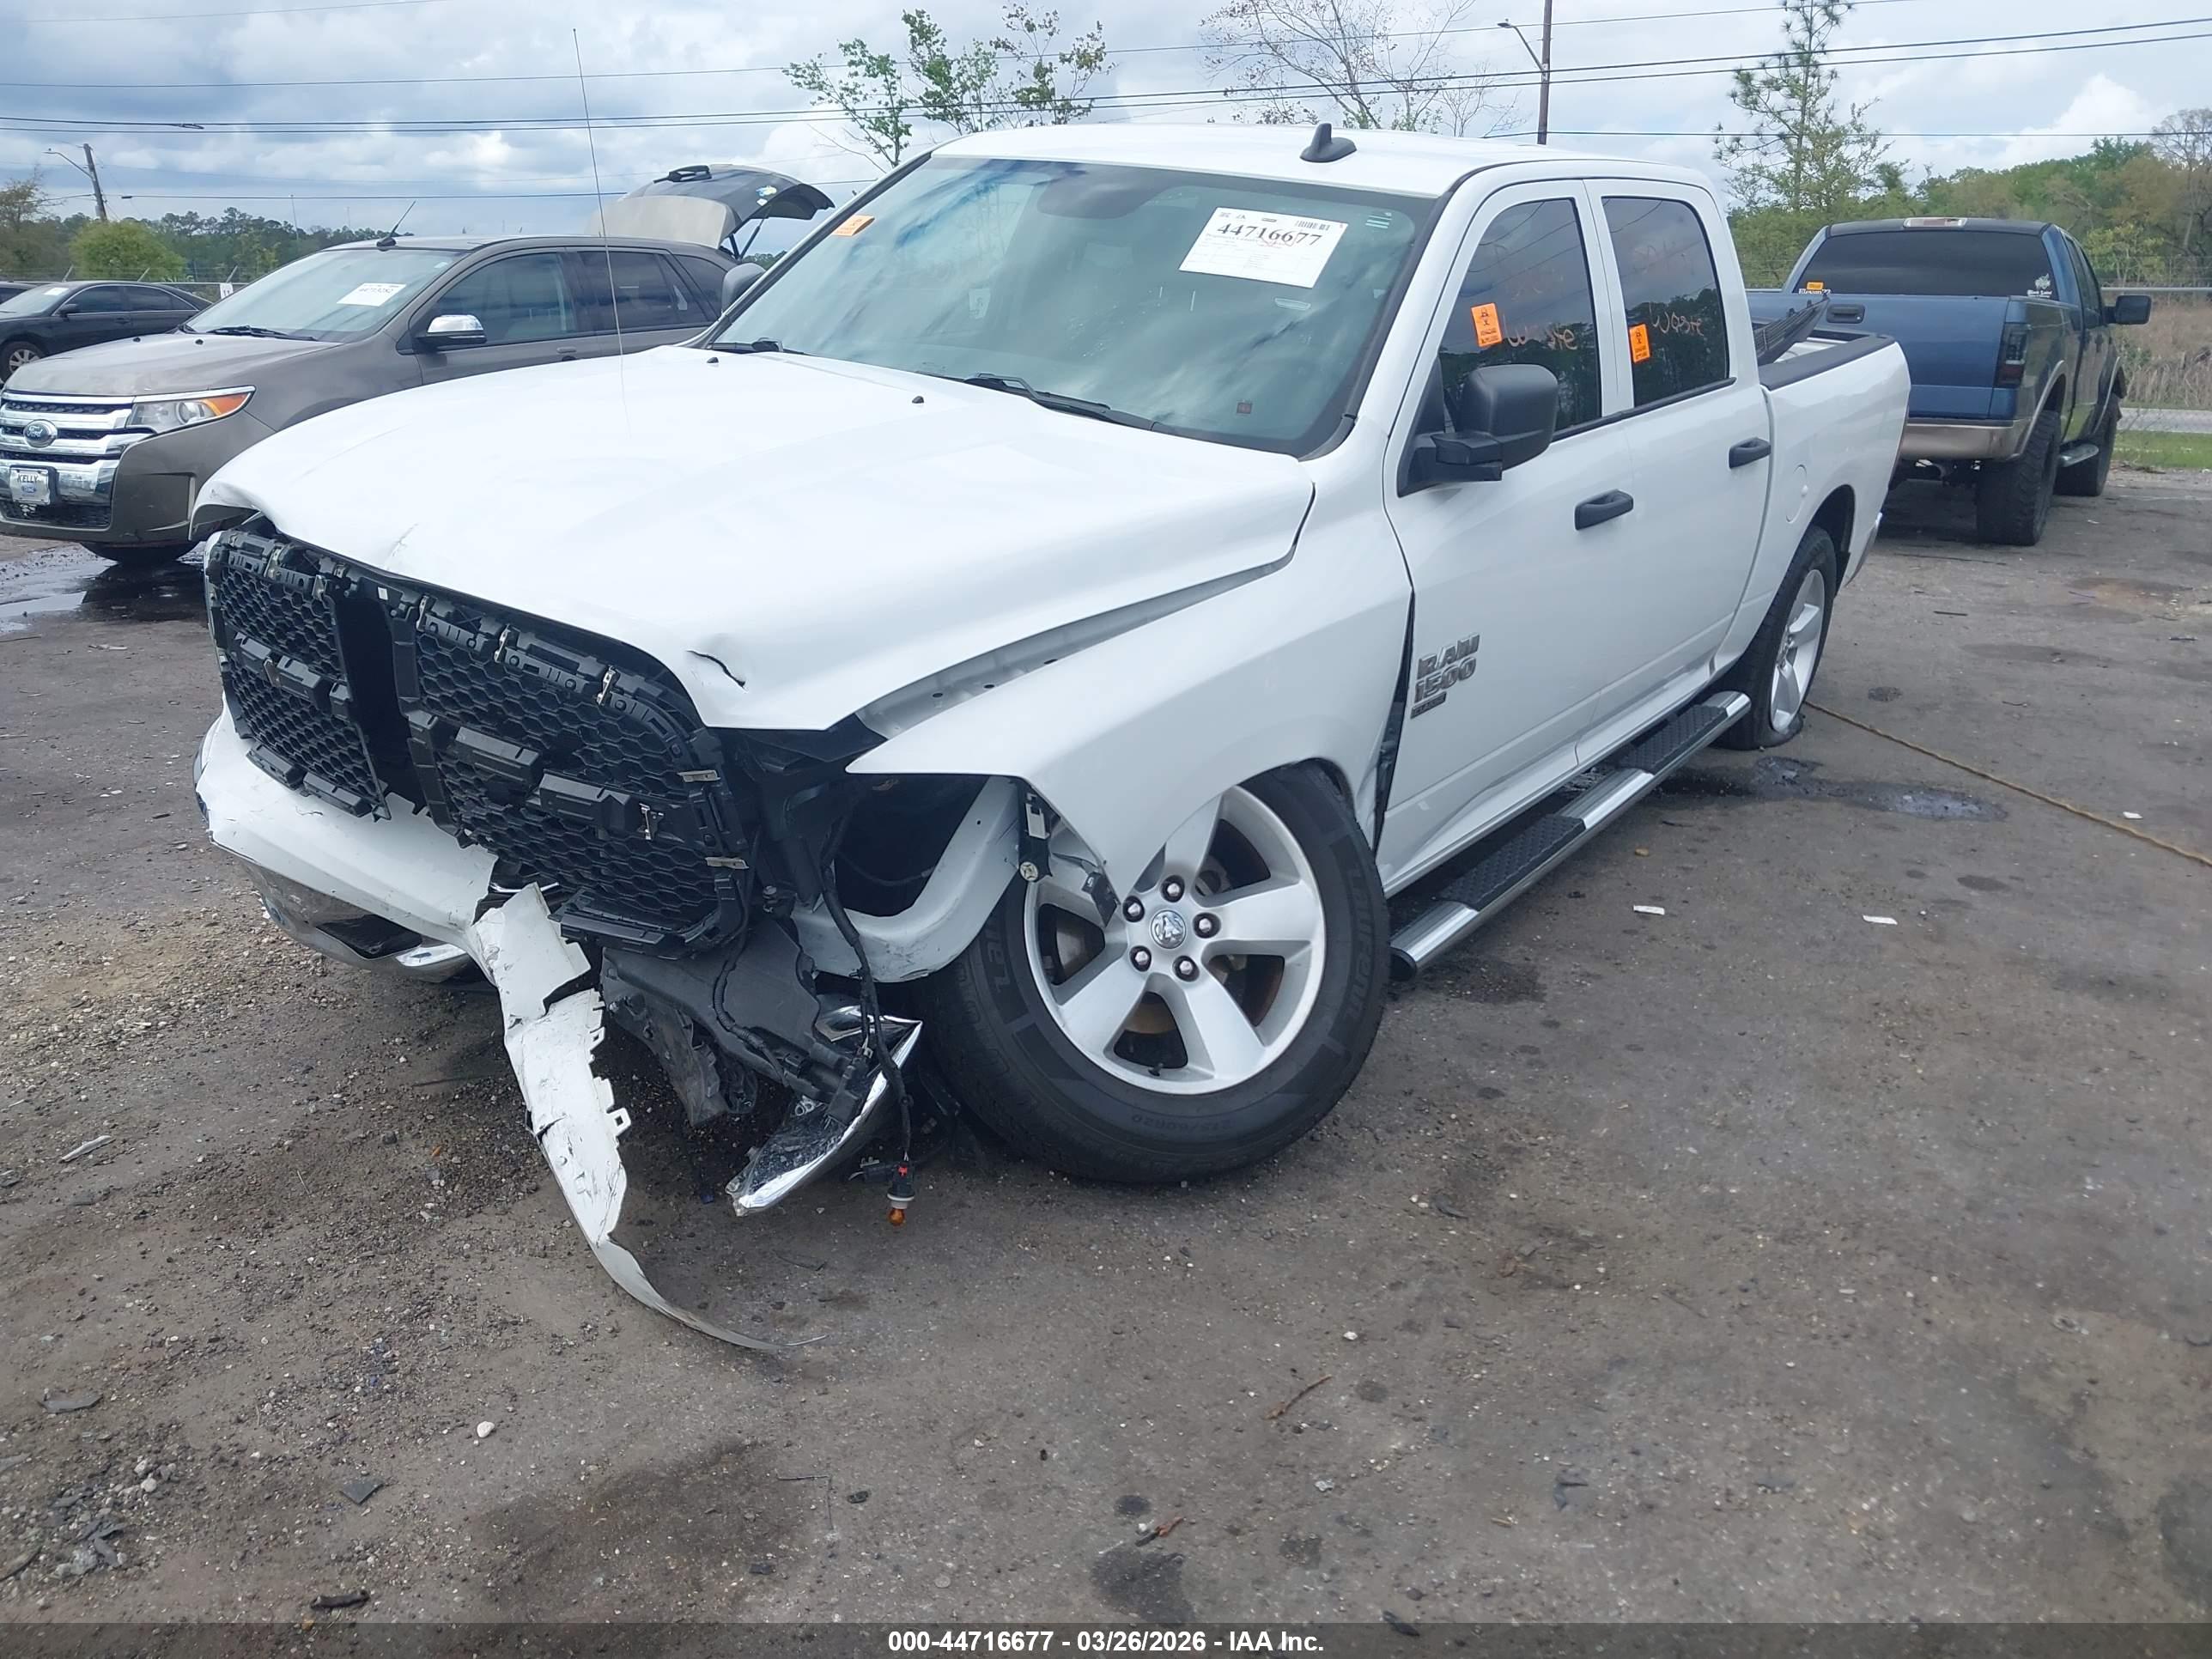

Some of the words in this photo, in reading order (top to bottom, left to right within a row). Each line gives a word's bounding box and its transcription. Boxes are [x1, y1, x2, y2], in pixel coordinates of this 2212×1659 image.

[1217, 223, 1322, 246] 44716677
[17, 474, 39, 483] KELLY
[1416, 632, 1481, 680] RAM
[1413, 656, 1477, 703] 1500
